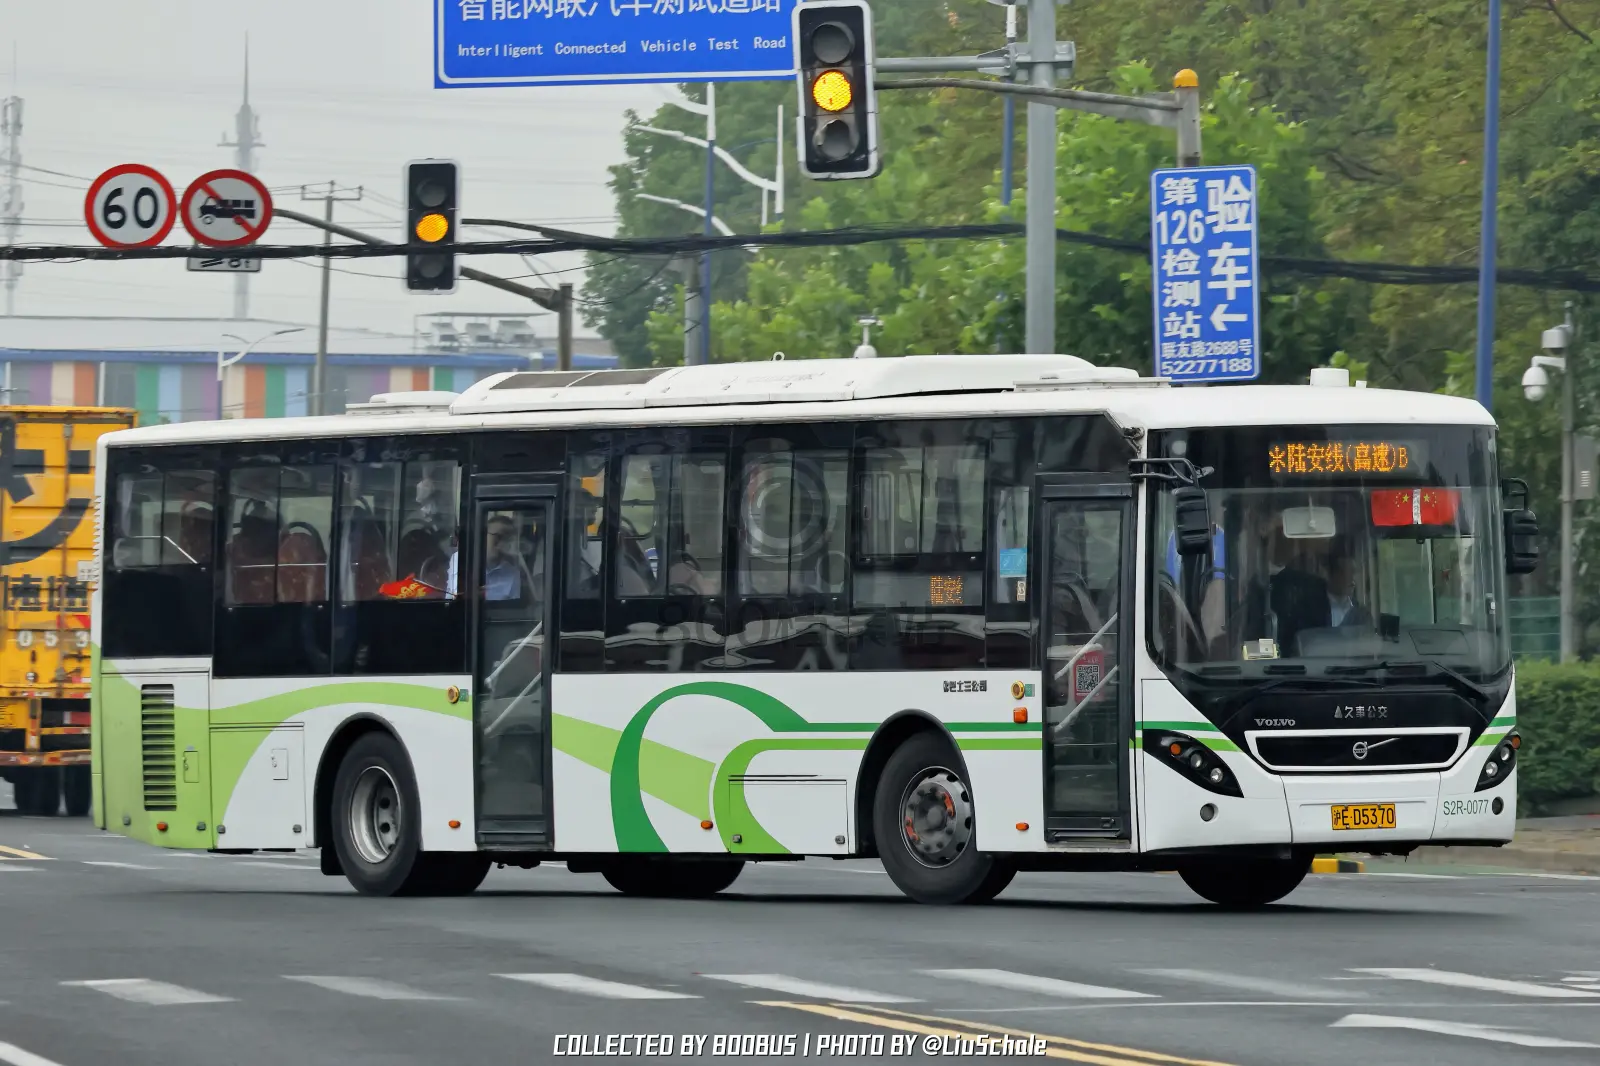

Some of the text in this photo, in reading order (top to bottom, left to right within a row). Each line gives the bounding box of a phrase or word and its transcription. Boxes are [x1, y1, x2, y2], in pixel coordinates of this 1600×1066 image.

[554, 41, 627, 55] Connected
[641, 39, 697, 53] Vehicle
[708, 38, 740, 50] Test
[753, 36, 787, 49] Road
[103, 187, 158, 229] 60
[1161, 358, 1253, 375] 52277188
[1344, 705, 1388, 718] 久事公交
[1254, 718, 1296, 727] VOLVO
[1443, 800, 1489, 815] S2R-0077
